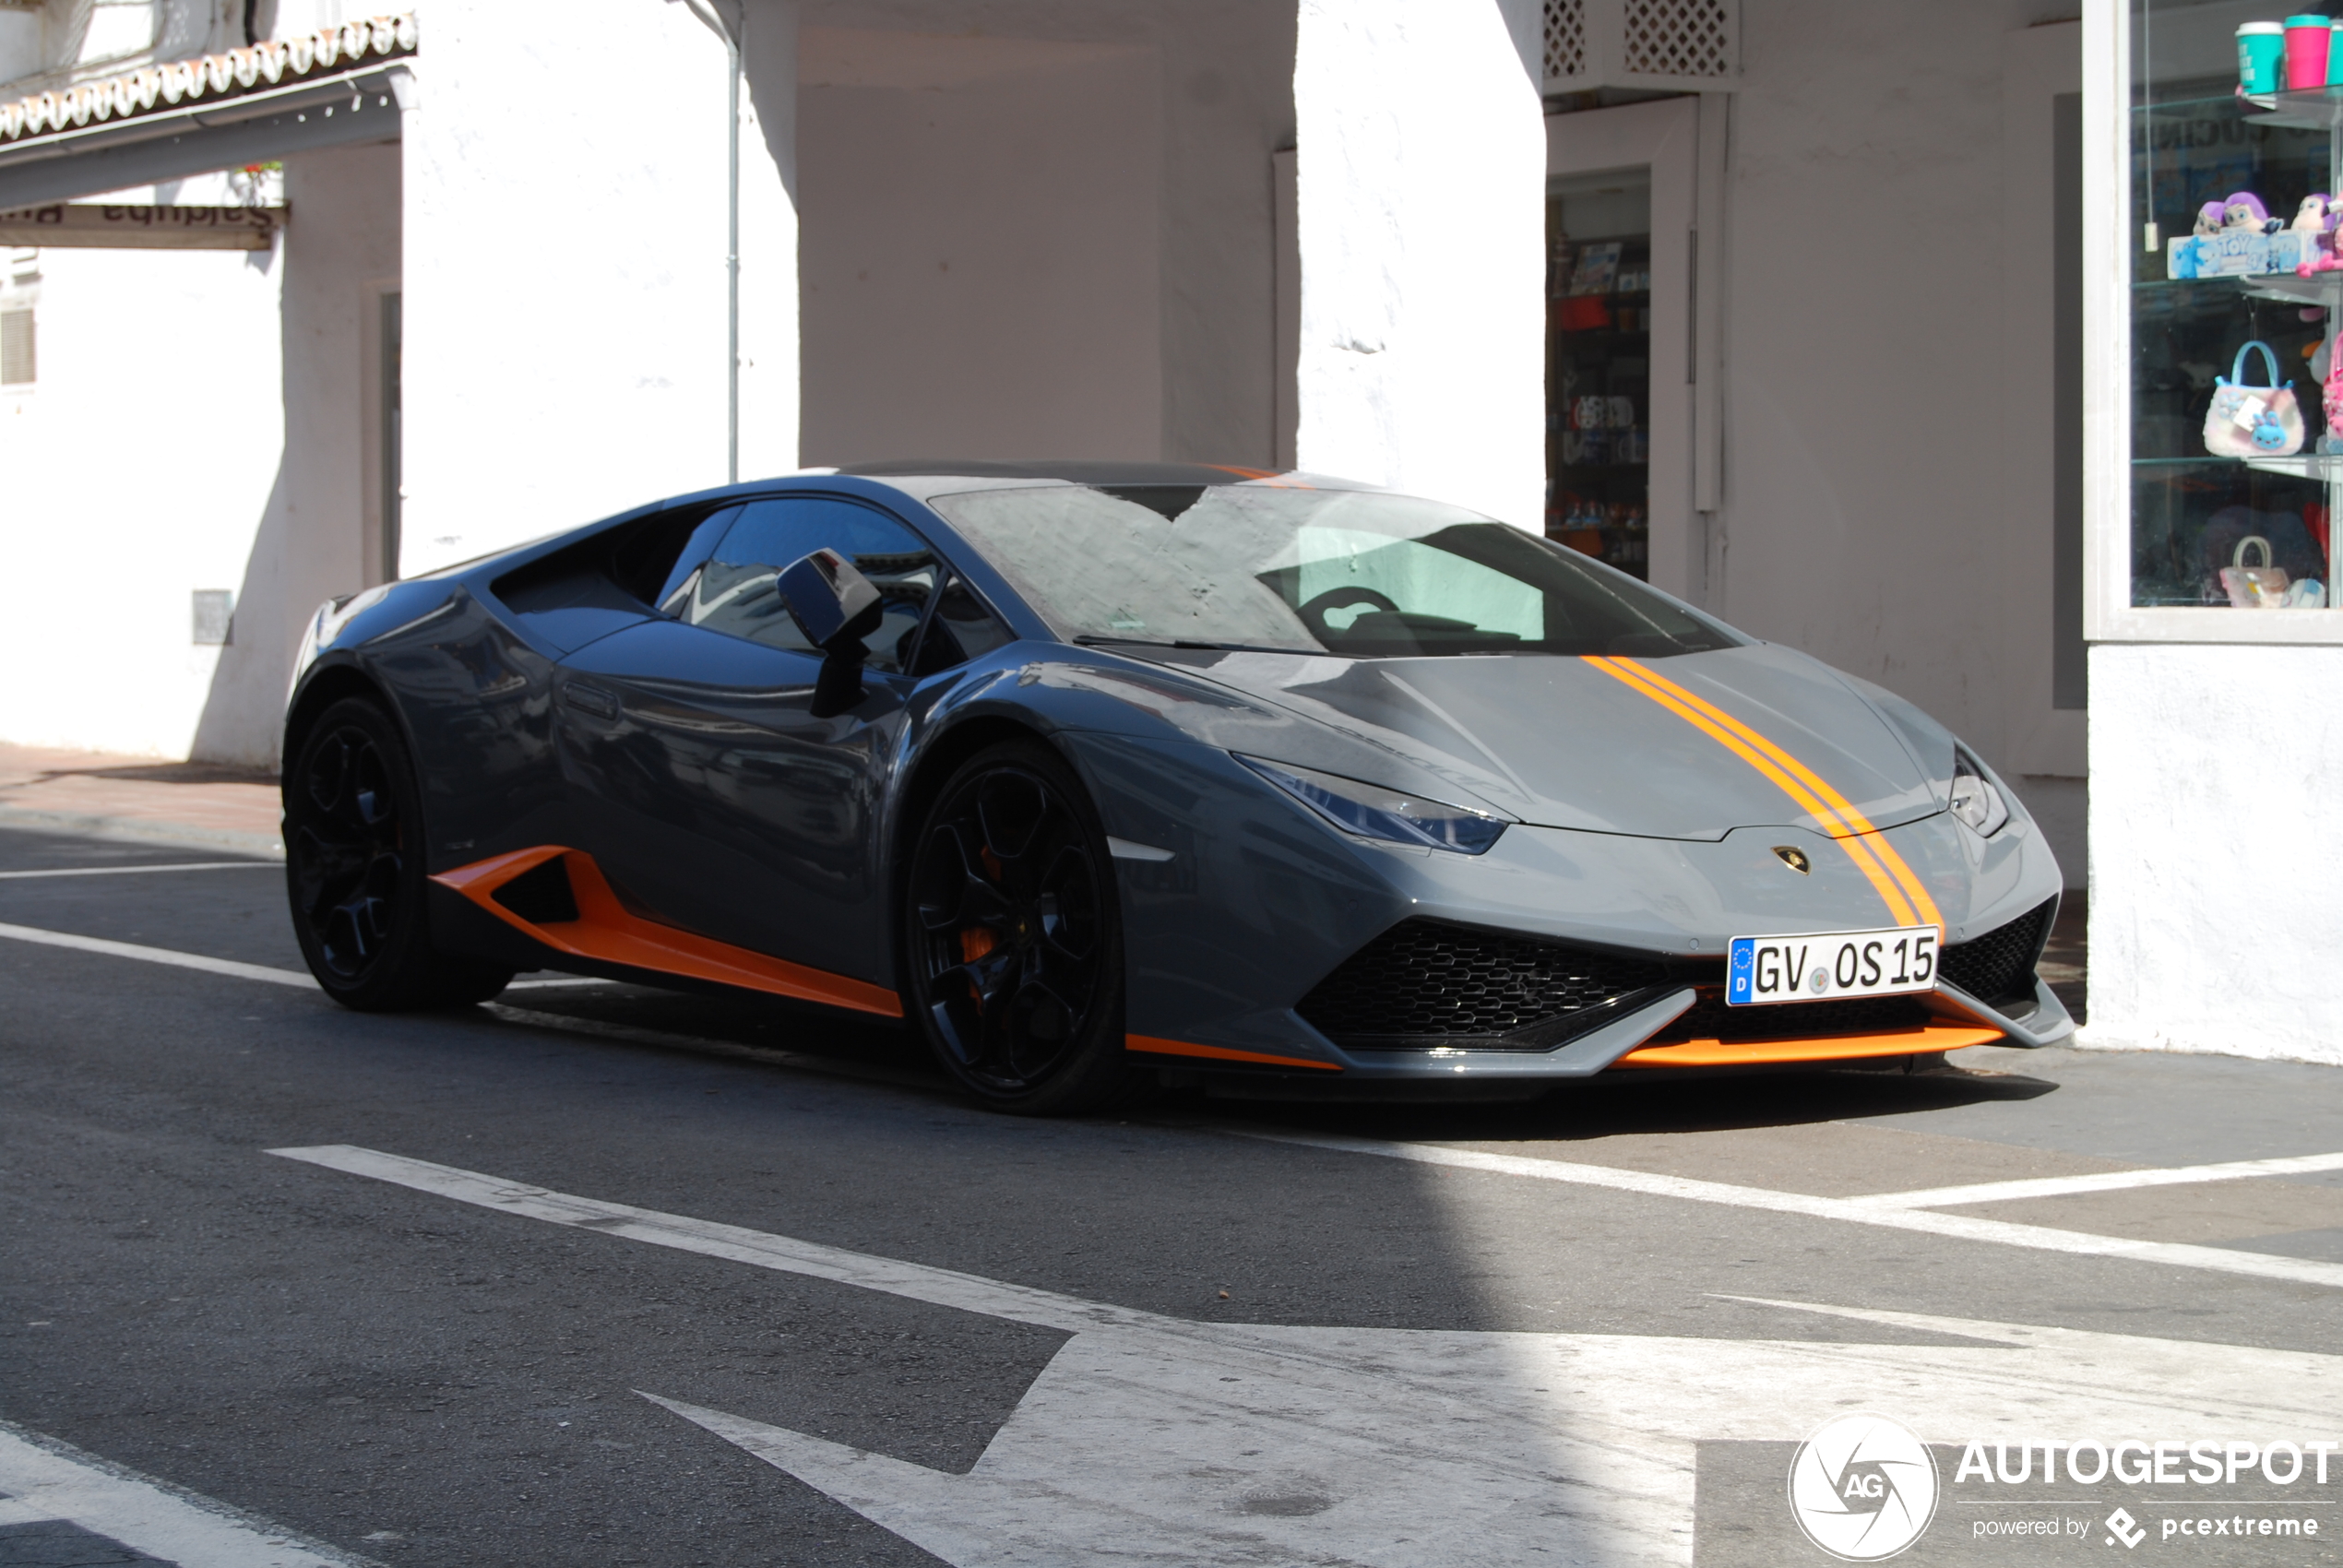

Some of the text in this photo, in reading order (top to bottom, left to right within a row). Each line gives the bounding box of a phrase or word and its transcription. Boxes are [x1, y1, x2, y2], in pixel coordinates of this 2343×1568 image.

[2217, 232, 2253, 256] TOY
[1756, 936, 1934, 992] GV OS 15
[1736, 977, 1747, 992] D
